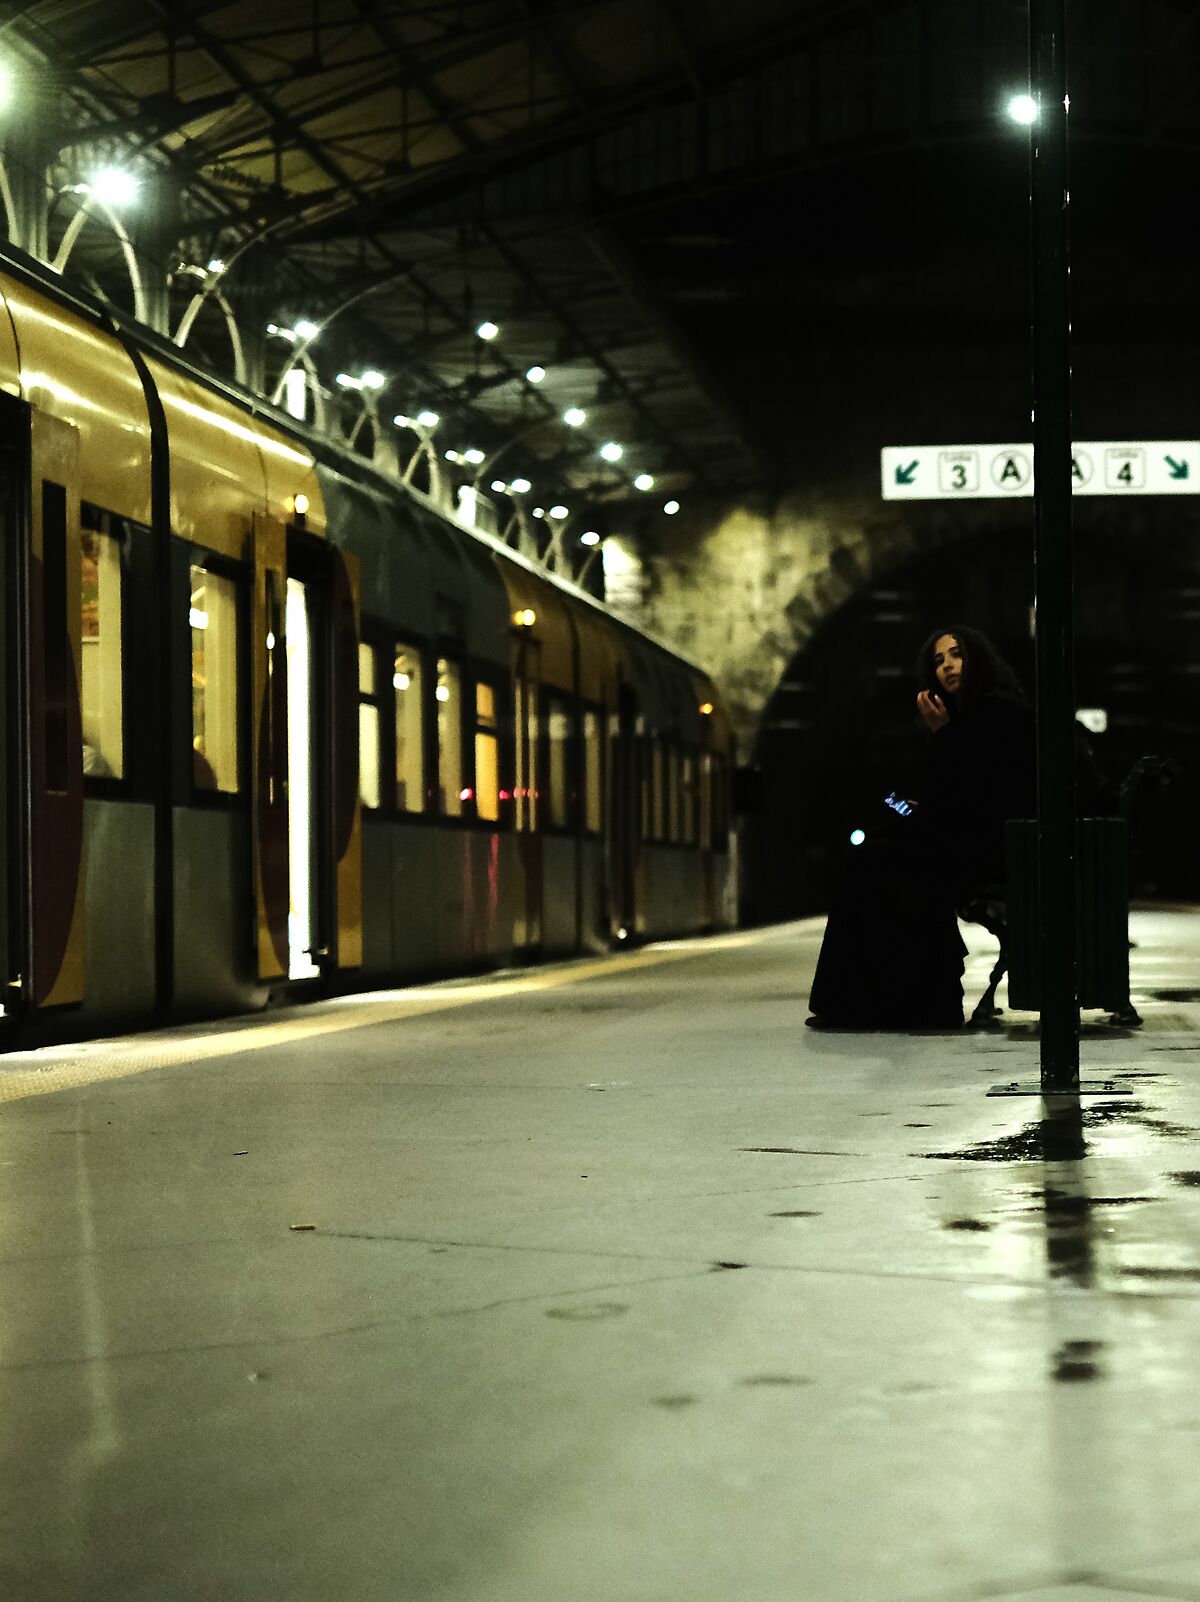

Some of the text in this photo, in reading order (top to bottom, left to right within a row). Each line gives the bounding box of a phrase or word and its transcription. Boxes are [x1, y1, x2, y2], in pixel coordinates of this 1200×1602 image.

[952, 464, 967, 489] 3
[1000, 456, 1021, 481] A
[1117, 461, 1133, 484] 4
